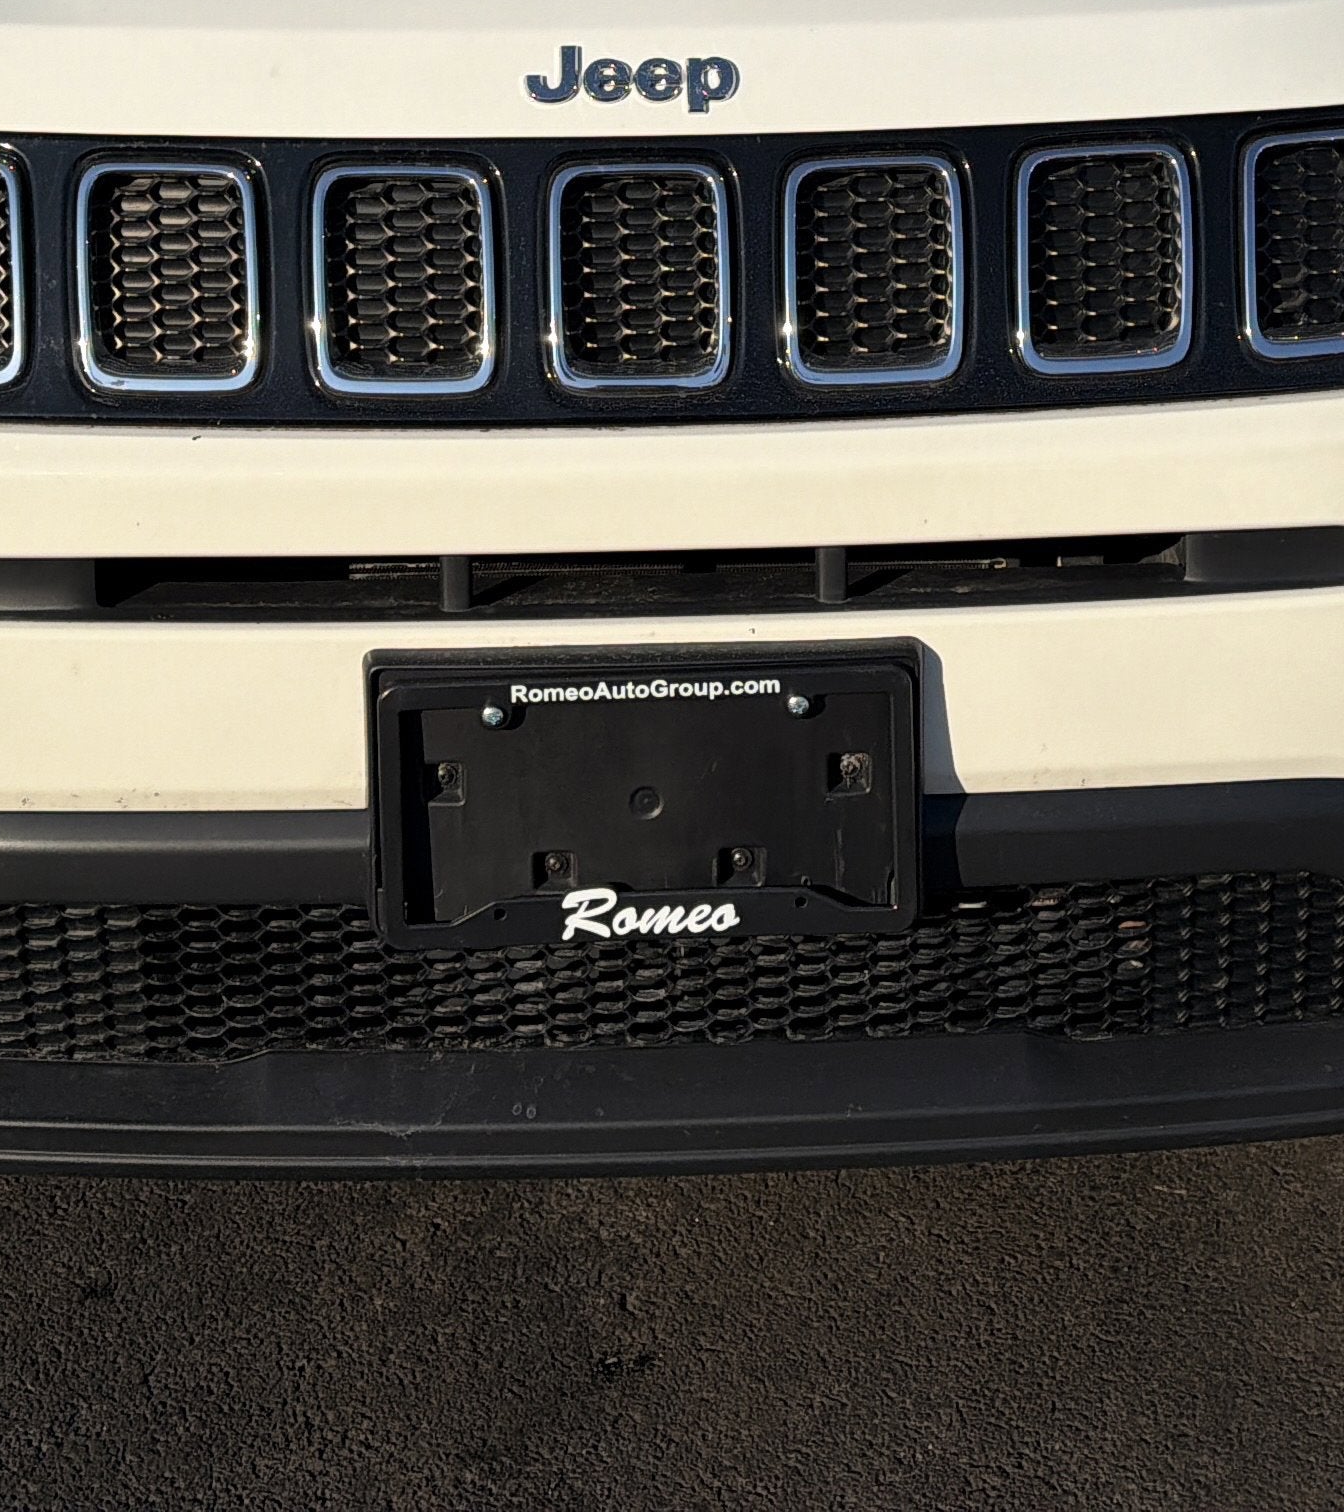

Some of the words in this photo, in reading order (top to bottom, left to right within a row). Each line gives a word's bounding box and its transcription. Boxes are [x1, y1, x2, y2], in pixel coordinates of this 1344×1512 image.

[524, 45, 741, 114] Jeep
[510, 679, 781, 704] RomeoAutoGroup.com
[560, 887, 741, 942] Romeo
